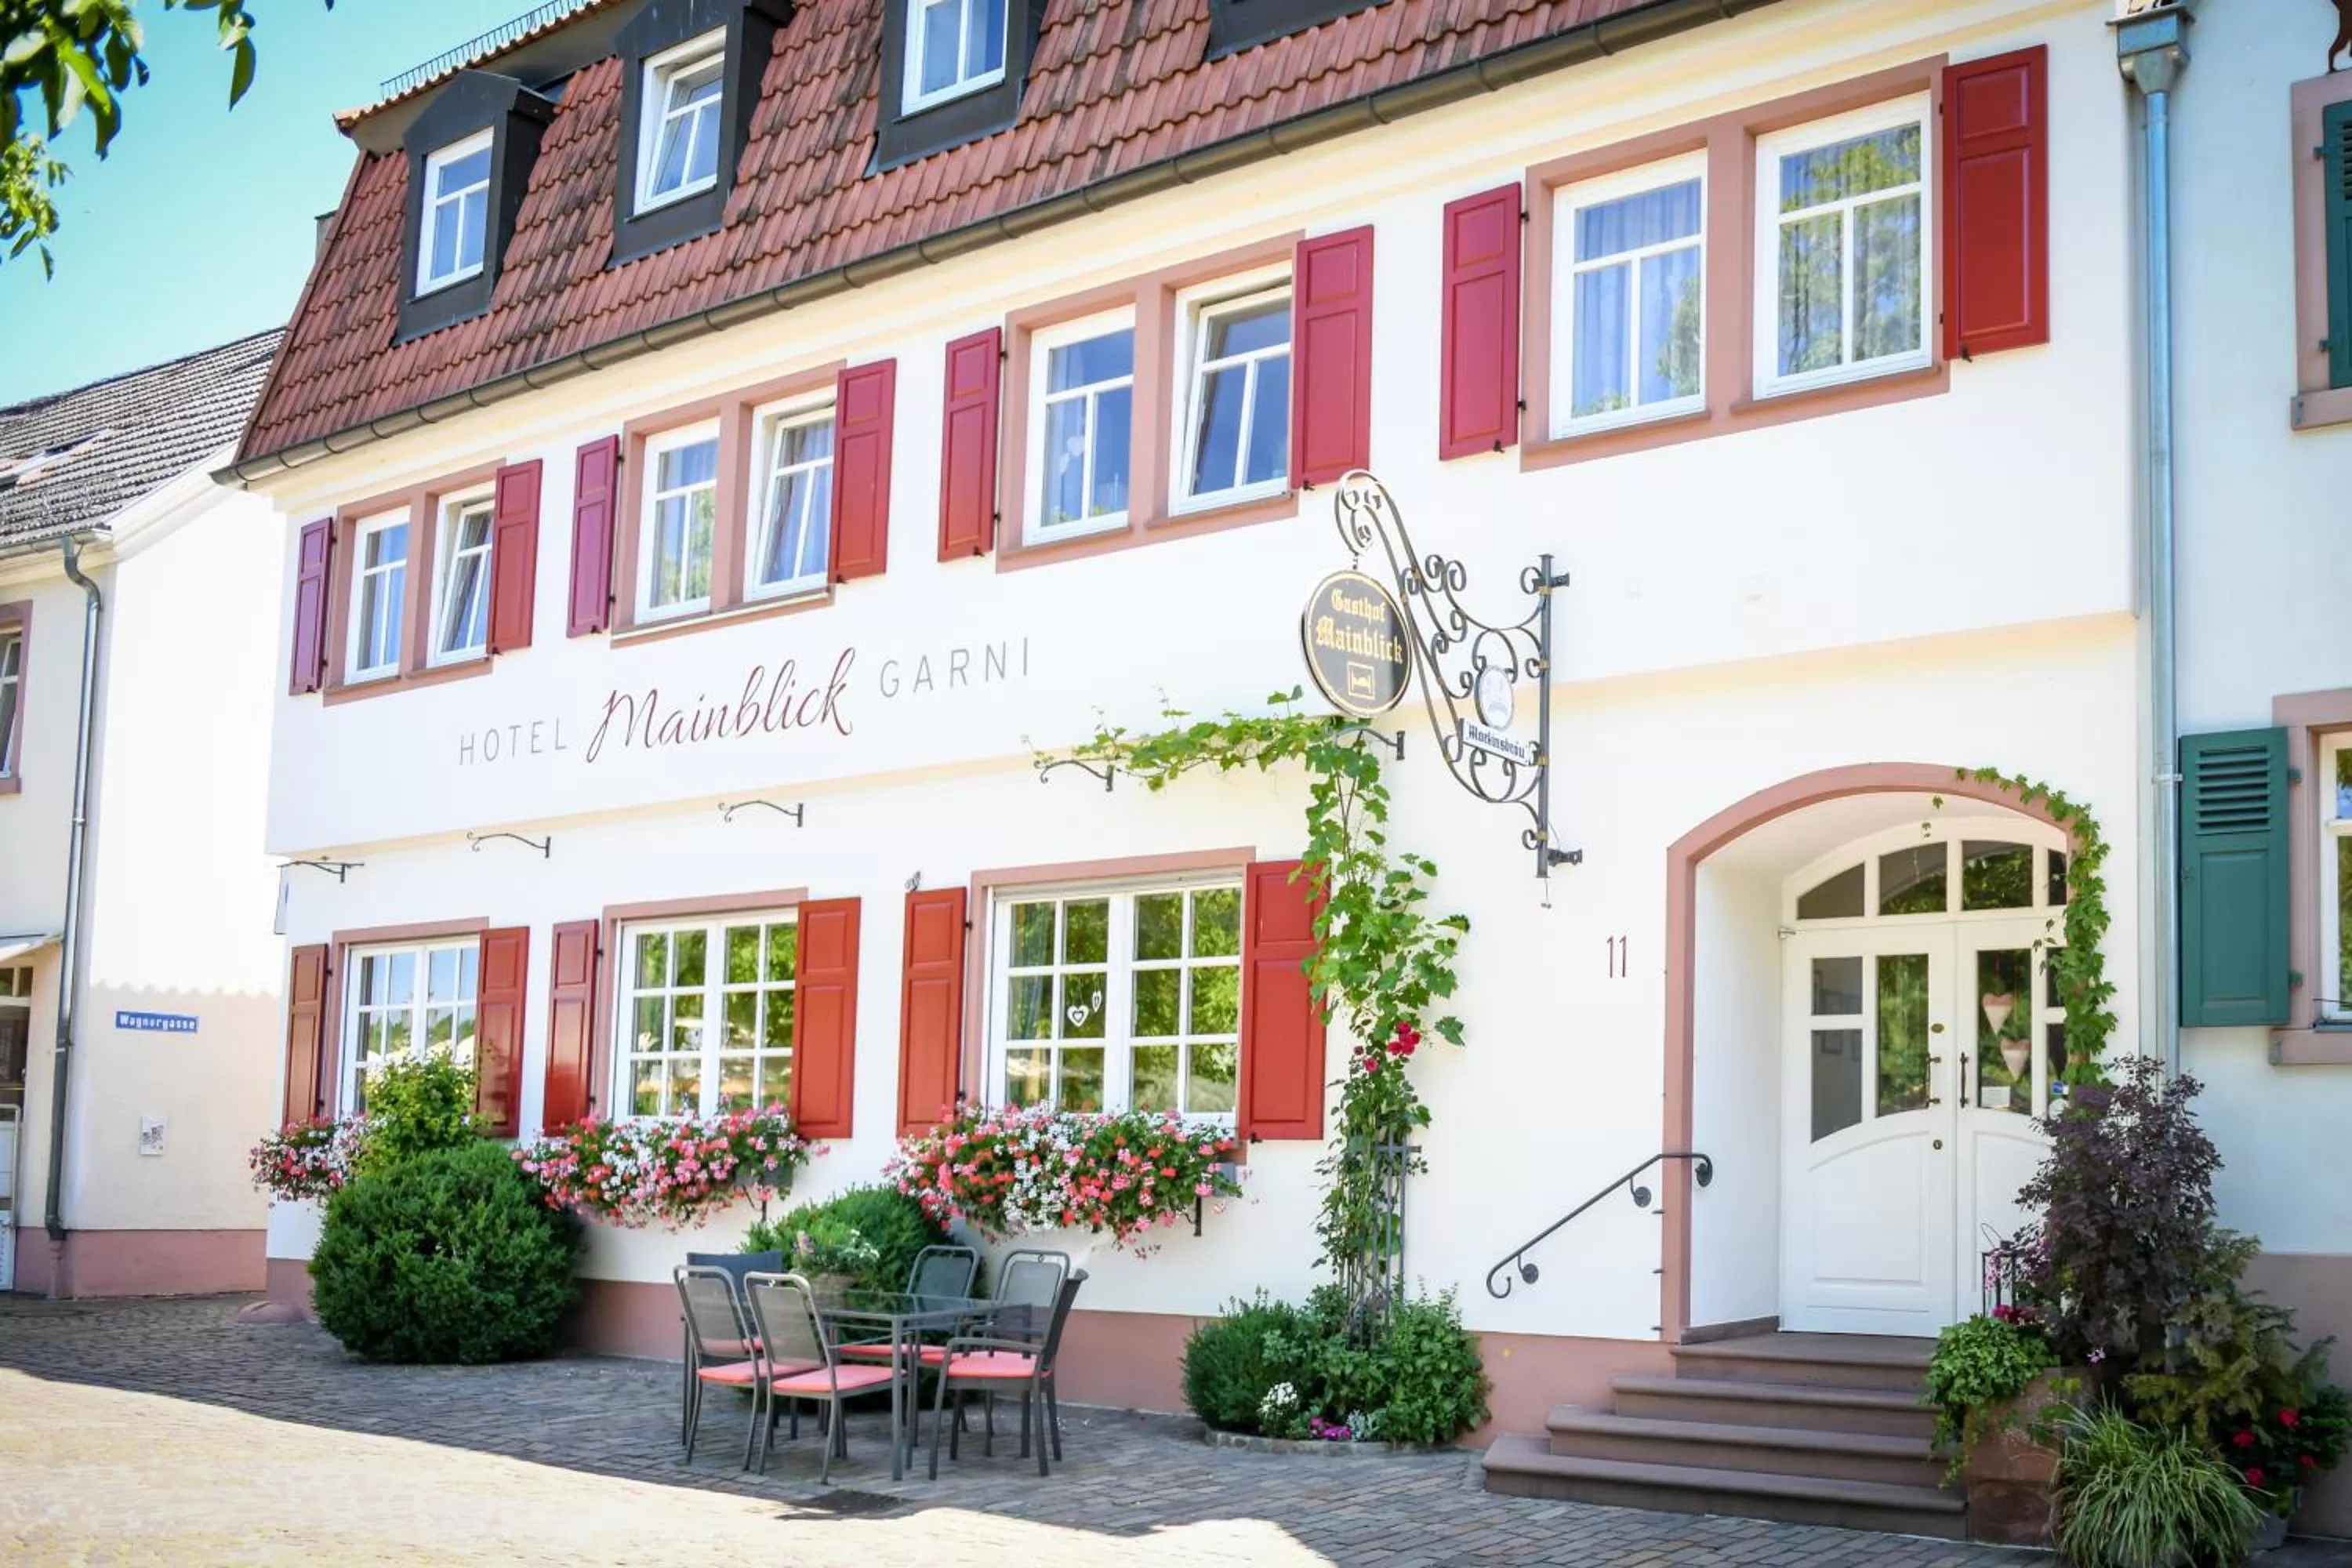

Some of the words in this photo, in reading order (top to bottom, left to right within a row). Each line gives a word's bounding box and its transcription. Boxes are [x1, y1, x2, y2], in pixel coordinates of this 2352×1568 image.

[1332, 589, 1385, 623] Gasthof
[1316, 615, 1403, 663] Mainblick
[459, 717, 568, 766] HOTEL
[586, 647, 854, 764] Mainblick
[880, 637, 1029, 699] GARNI
[1606, 935, 1627, 978] 11
